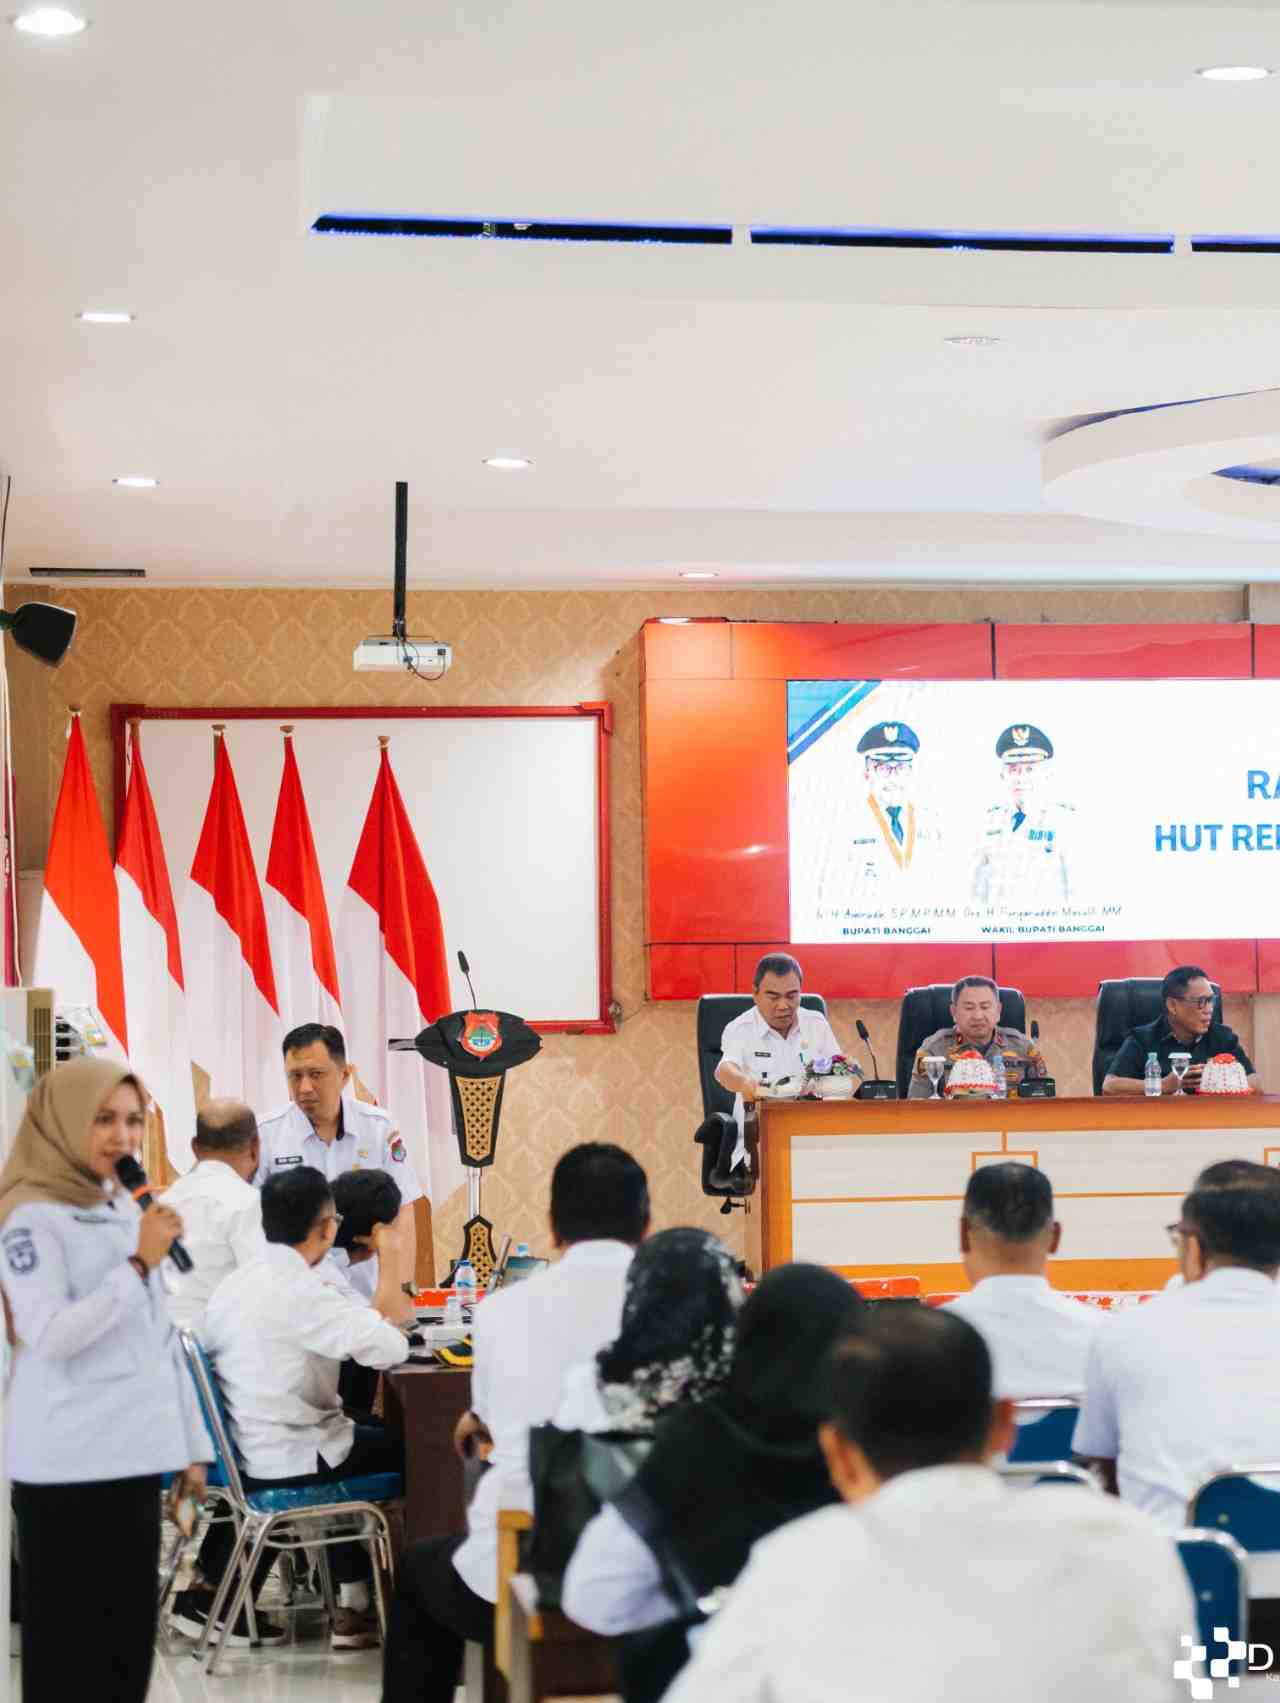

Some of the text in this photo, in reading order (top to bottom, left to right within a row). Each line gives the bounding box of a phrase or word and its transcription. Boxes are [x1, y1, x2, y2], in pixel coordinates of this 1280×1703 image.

[1154, 824, 1223, 851] HUT
[842, 927, 932, 936] BUPATI BANGGAI
[981, 924, 1105, 935] WAKIL BUPATI BANGGAI
